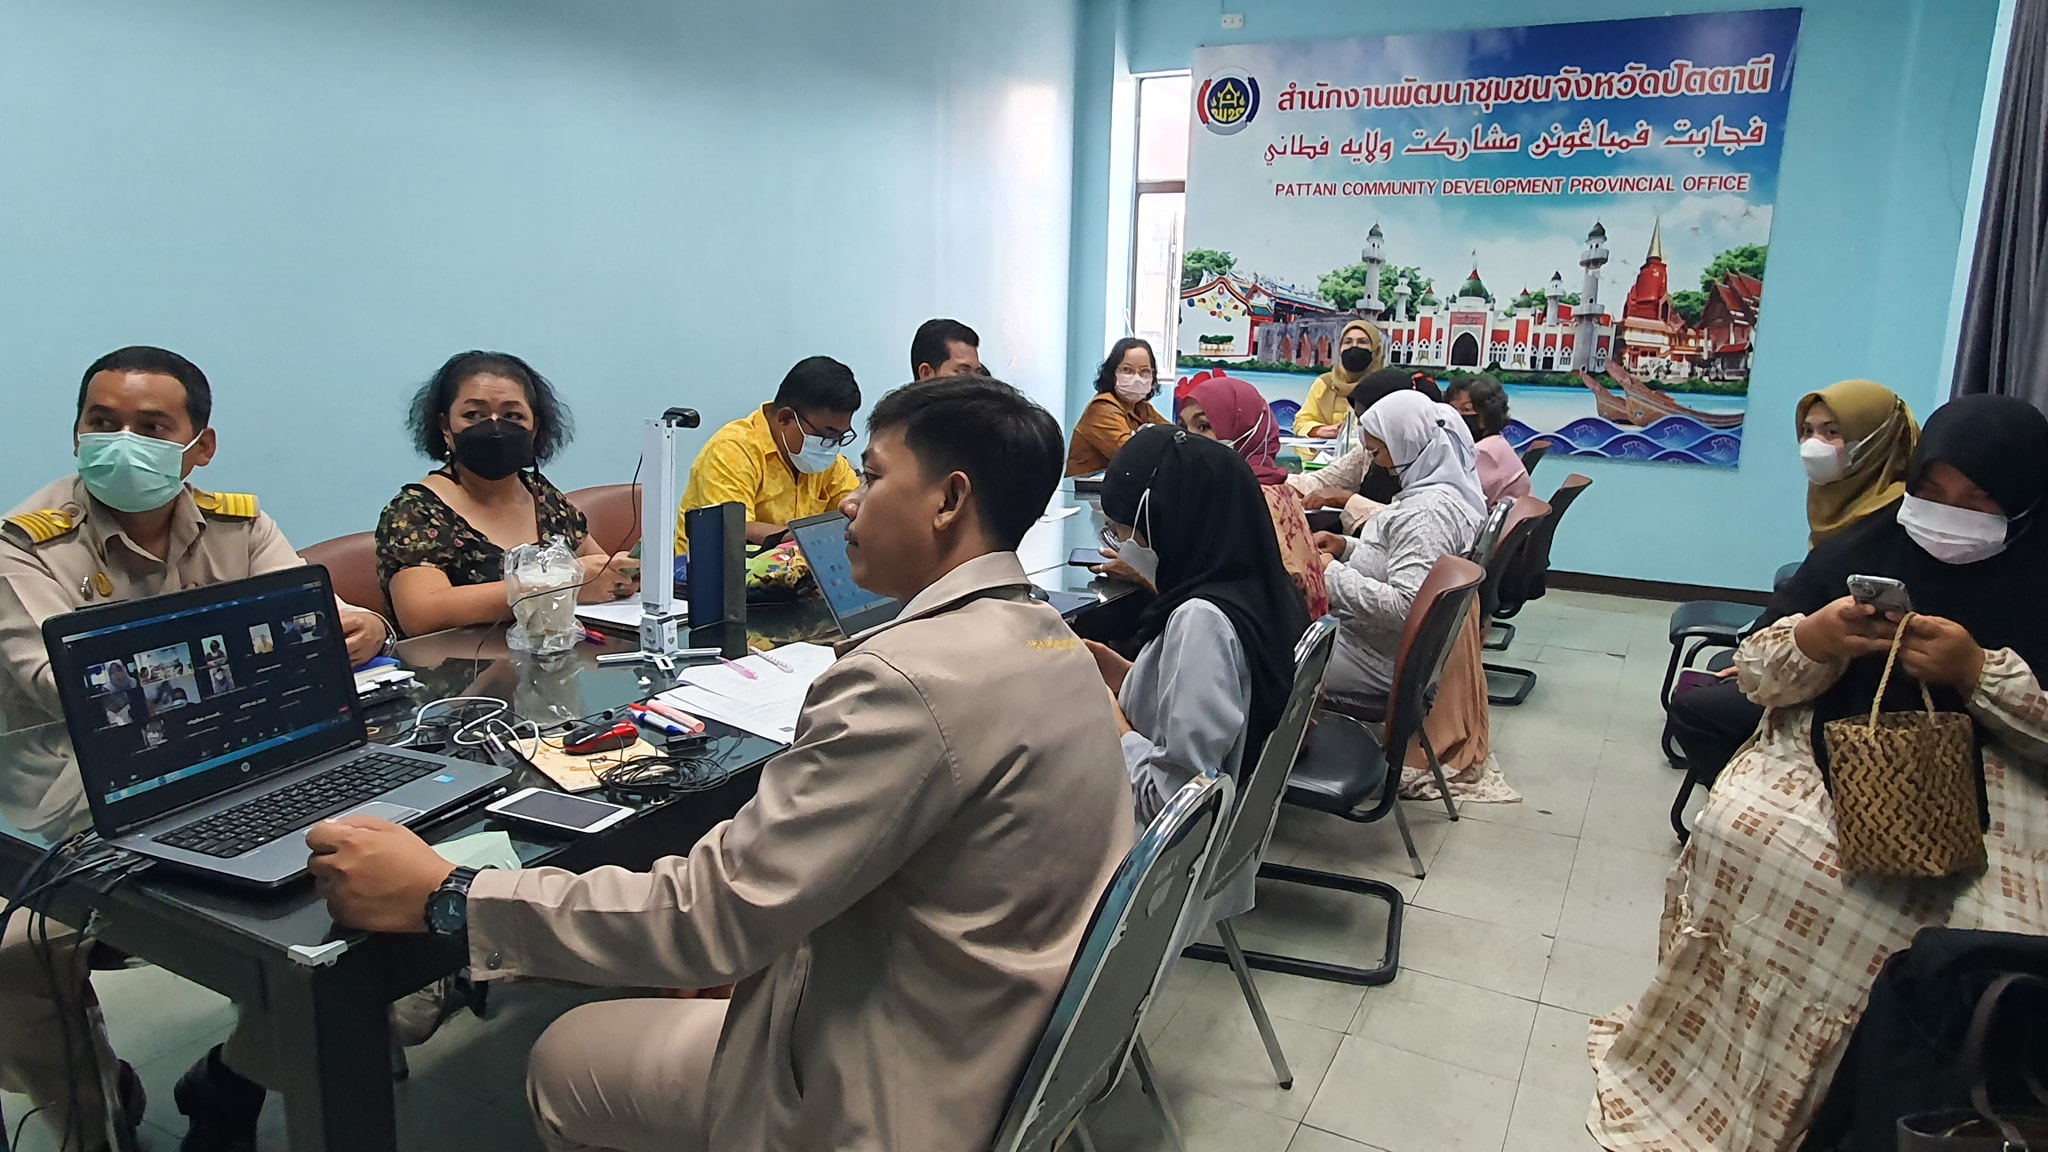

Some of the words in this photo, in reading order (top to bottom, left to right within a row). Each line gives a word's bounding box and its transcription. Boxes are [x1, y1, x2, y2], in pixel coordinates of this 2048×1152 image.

[1278, 57, 1771, 111] สำนักงานพัฒนาชุมชนจังหวัดปัตตานี
[1275, 182, 1337, 196] PATTANI
[1342, 180, 1437, 195] COMMUNITY
[1443, 179, 1564, 195] DEVELOPMENT
[1570, 176, 1675, 193] PROVINCIAL
[1682, 175, 1750, 191] OFFICE
